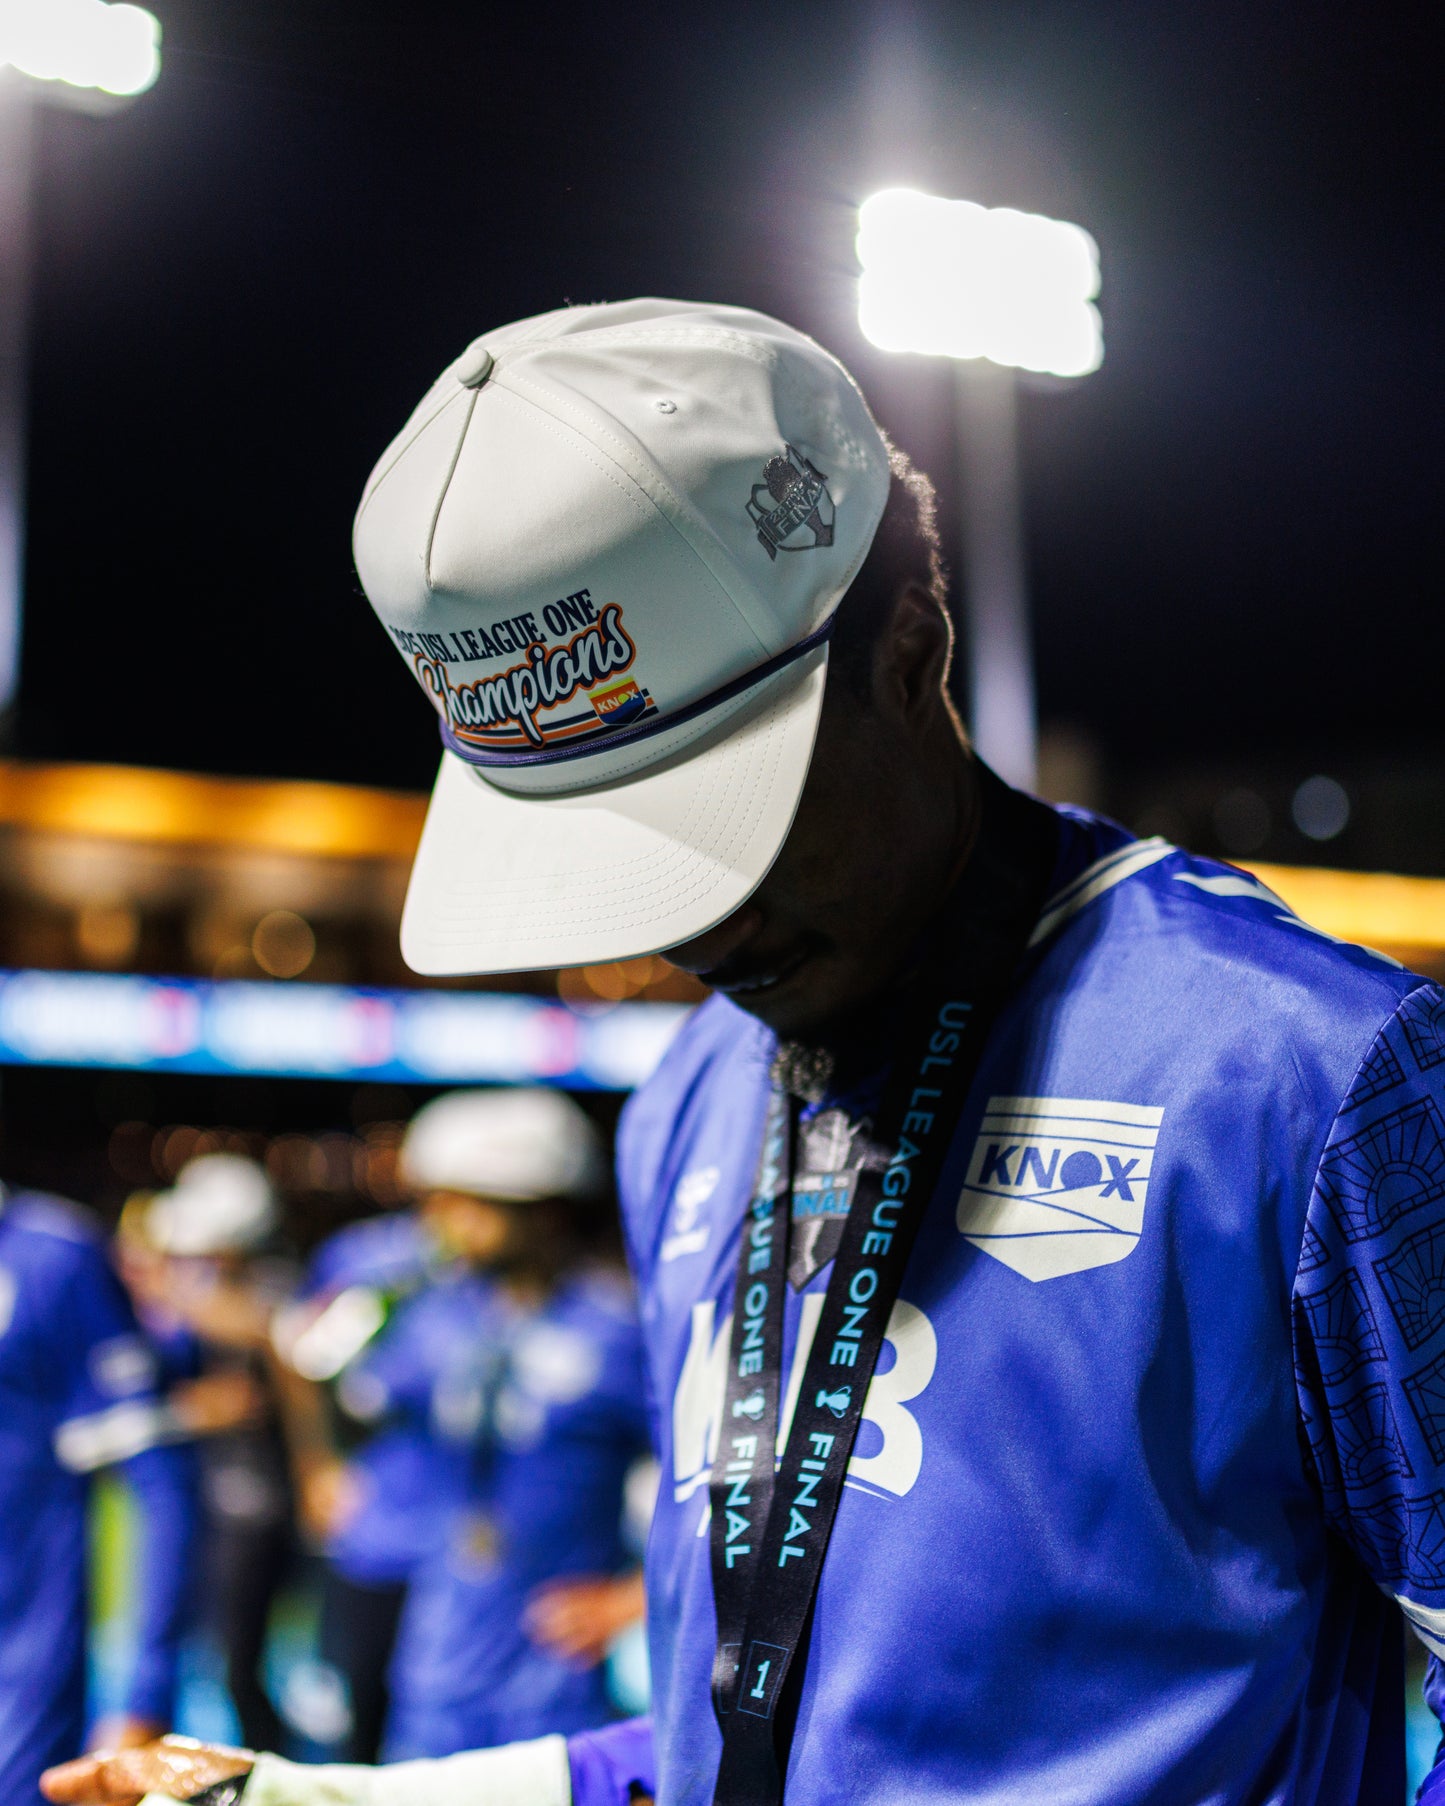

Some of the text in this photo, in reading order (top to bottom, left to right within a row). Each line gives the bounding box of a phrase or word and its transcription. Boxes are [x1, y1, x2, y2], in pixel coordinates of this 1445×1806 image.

[415, 633, 459, 663] USL
[449, 612, 548, 662] LEAGUE
[542, 588, 601, 637] ONE
[414, 603, 636, 749] Champions
[596, 687, 640, 714] KNOX
[977, 1143, 1140, 1202] KNOX
[777, 1001, 973, 1569] USL LEAGUE ONE FINAL
[738, 1282, 770, 1378] ONE
[723, 1434, 758, 1570] FINAL
[749, 1659, 771, 1699] 1
